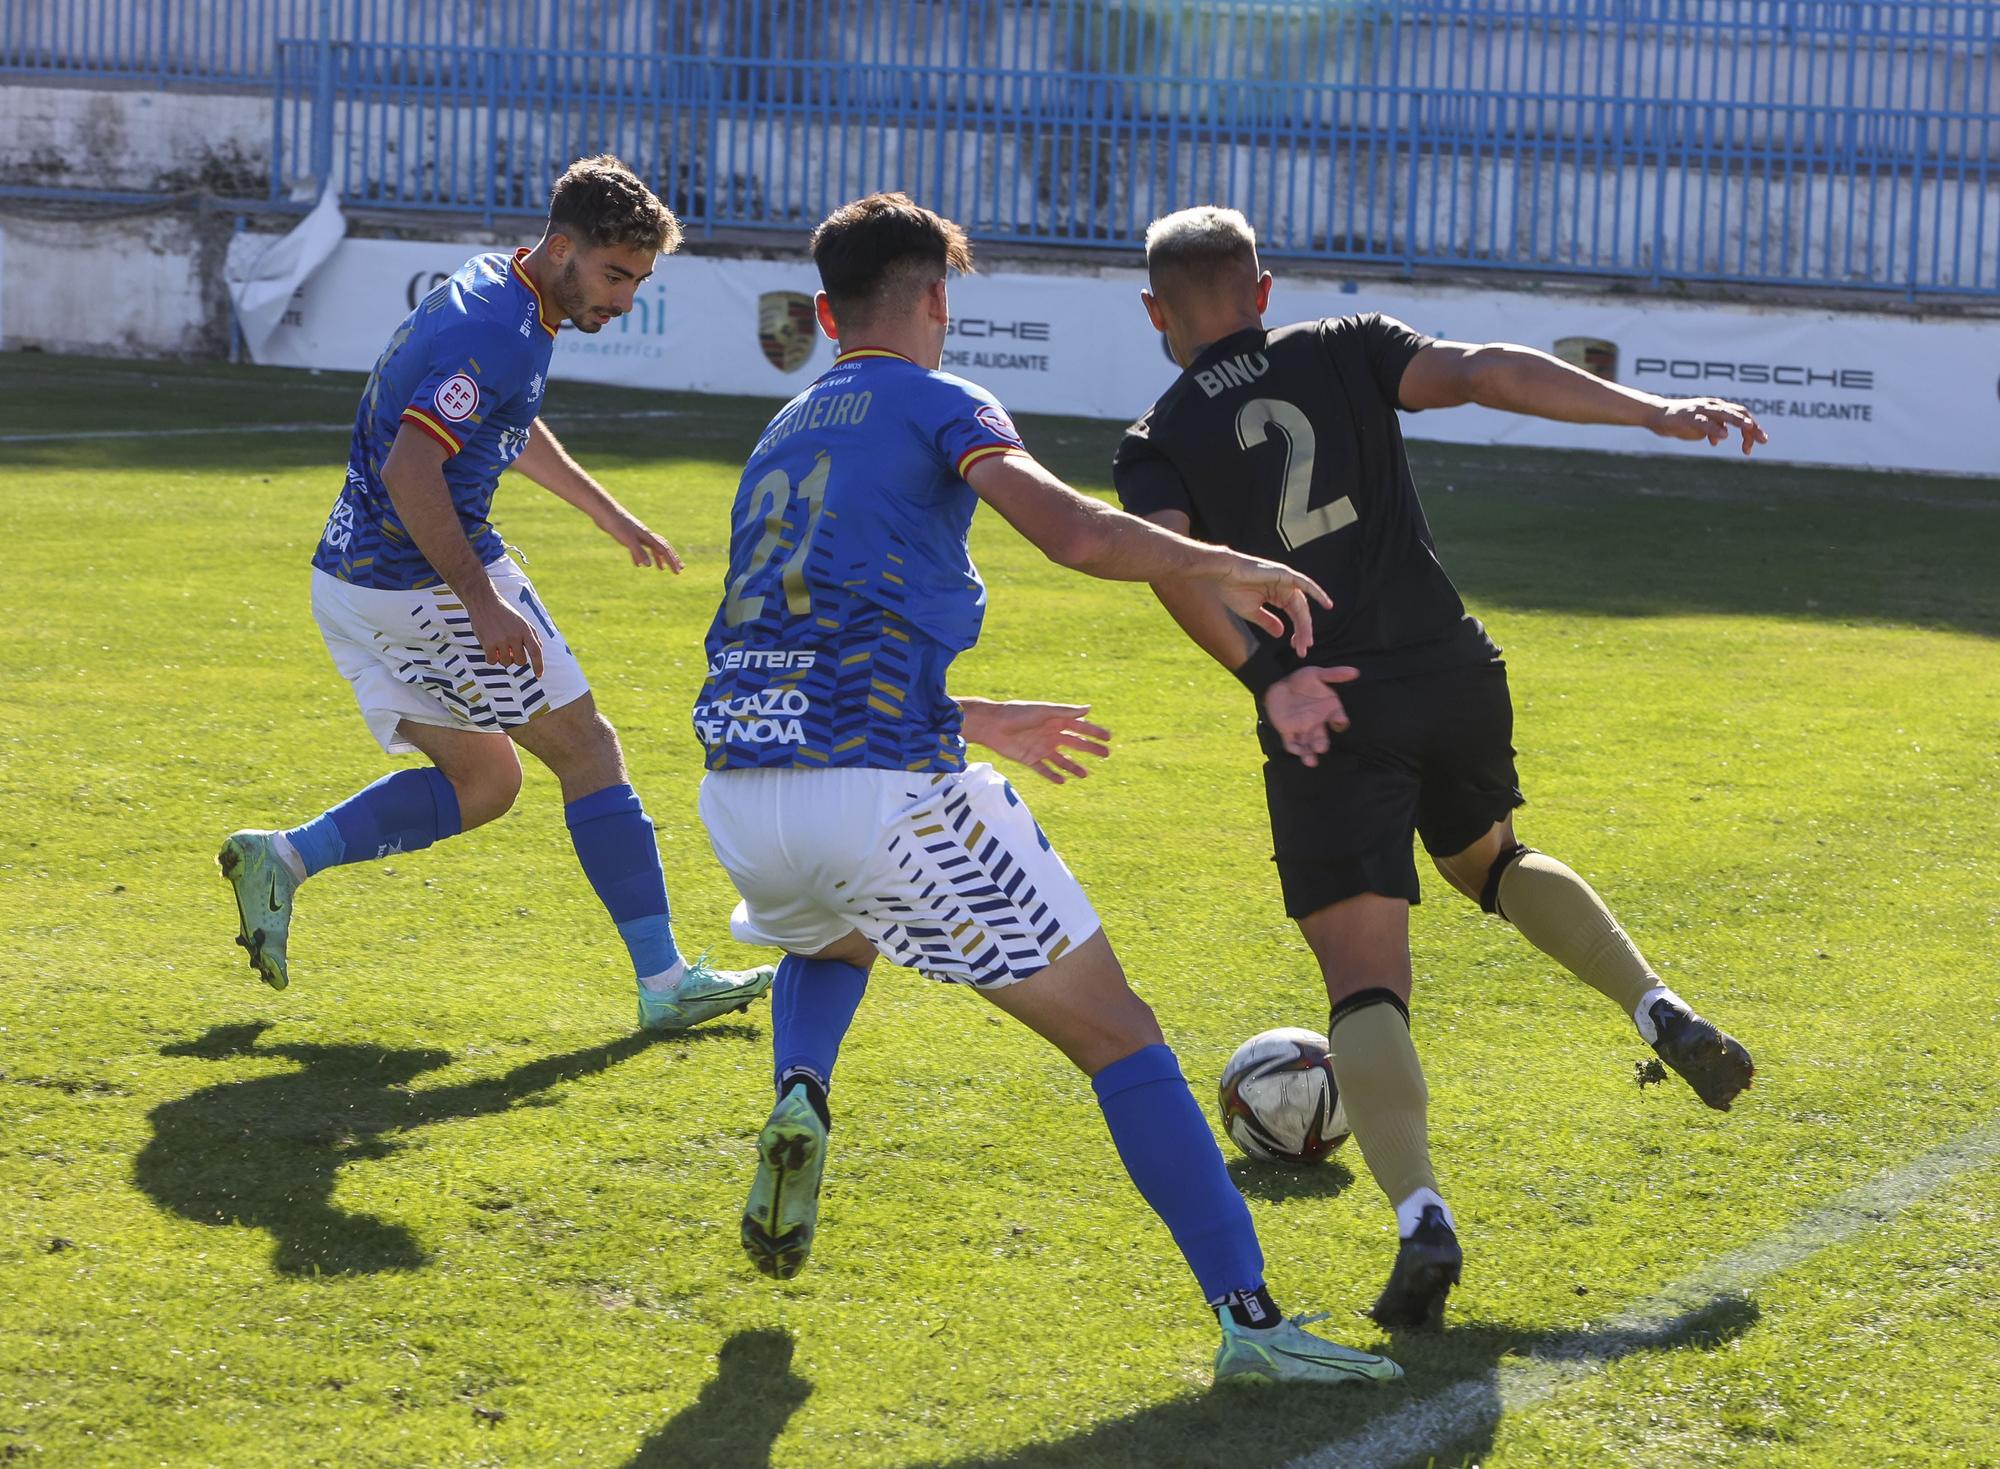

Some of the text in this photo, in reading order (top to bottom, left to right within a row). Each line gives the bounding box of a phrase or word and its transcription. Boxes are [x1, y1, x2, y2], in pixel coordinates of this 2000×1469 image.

[972, 351, 1049, 372] ALICANTE
[1635, 357, 1874, 390] PORSCHE
[1789, 401, 1873, 422] ALICANTE
[1235, 398, 1359, 552] 2
[725, 453, 832, 628] 21
[725, 718, 808, 745] NOVA
